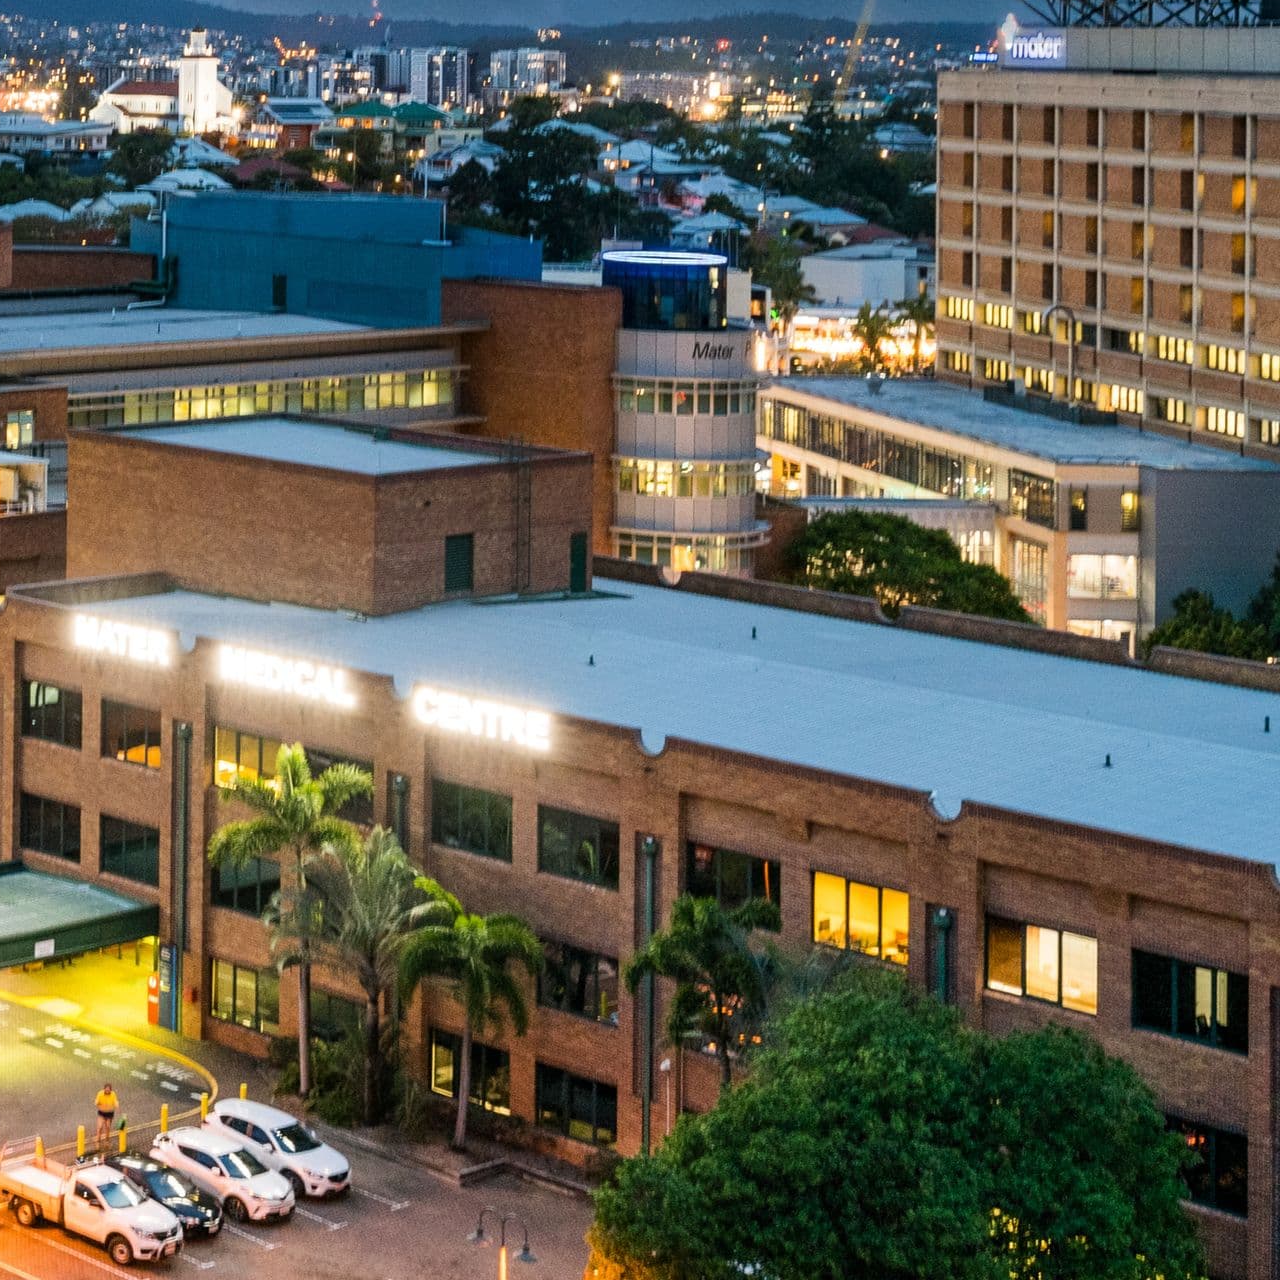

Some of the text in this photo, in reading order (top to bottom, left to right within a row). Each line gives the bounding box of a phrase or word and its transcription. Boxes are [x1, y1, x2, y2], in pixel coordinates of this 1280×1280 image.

[1012, 31, 1062, 59] mater
[692, 340, 735, 361] Mater
[75, 614, 552, 752] MATER MEDICAL CENTRE
